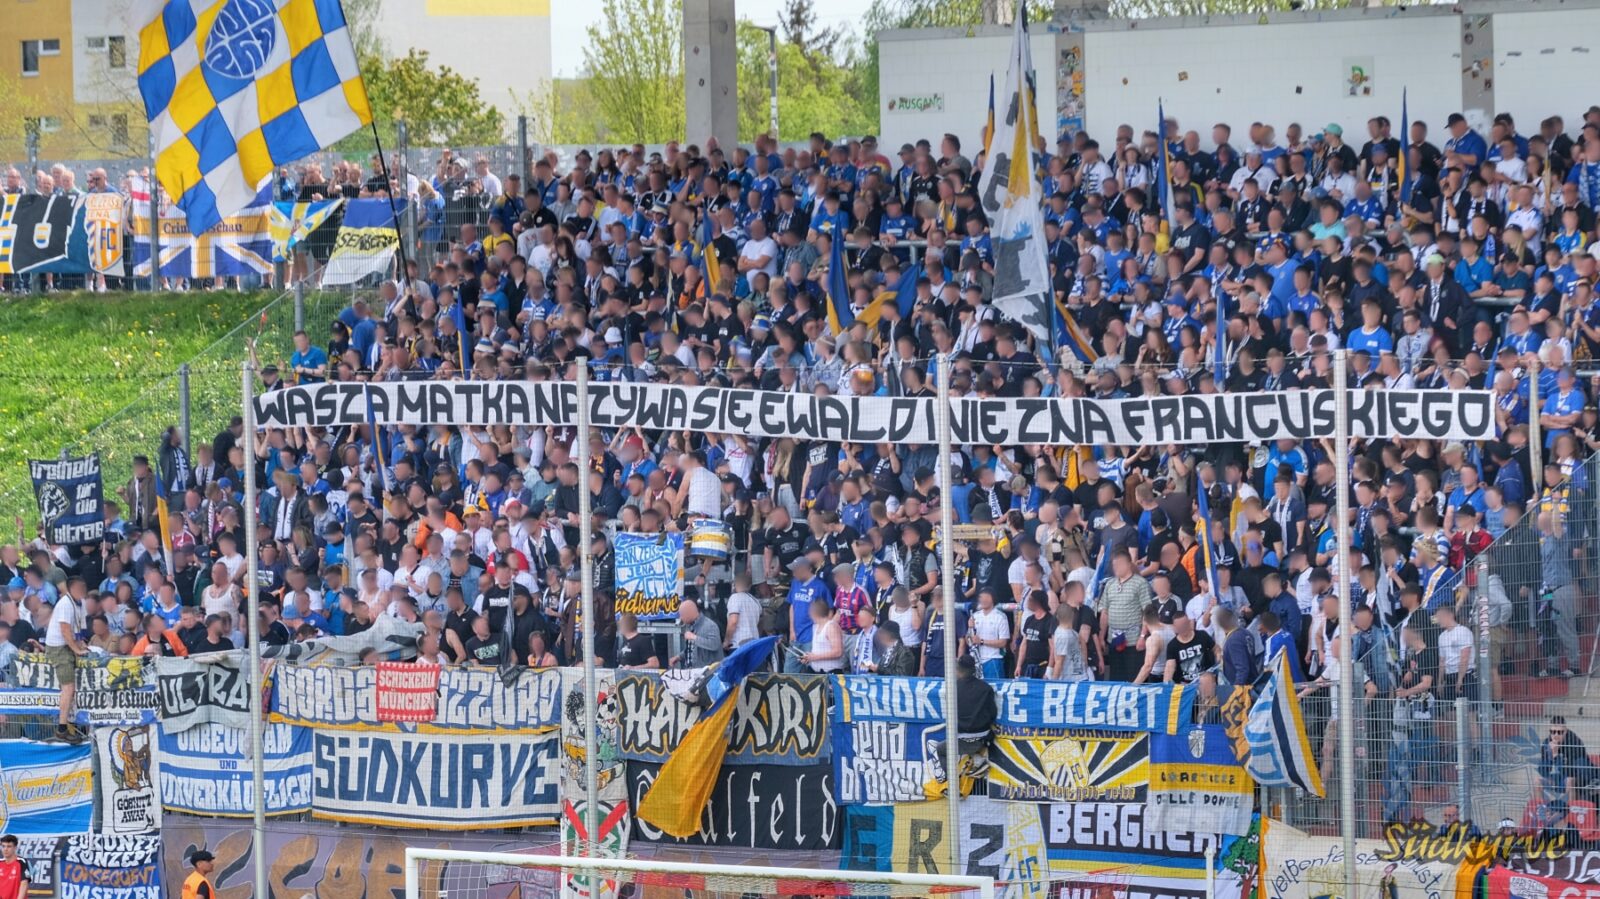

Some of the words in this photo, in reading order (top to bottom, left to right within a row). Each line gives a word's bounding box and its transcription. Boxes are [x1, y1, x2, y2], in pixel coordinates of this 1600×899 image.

[163, 221, 243, 234] Crimschau
[252, 383, 390, 426] WASZA
[397, 383, 530, 424] MATKA
[534, 383, 687, 428] NAZYWA
[691, 388, 754, 434] SIĘ
[759, 393, 918, 441] EWALD
[949, 398, 1009, 443] NIE
[1016, 399, 1116, 443] ZNA
[1120, 390, 1491, 443] FRANCUSKIEGO
[615, 589, 680, 615] üdkurve
[14, 660, 111, 692] WEIAR
[378, 688, 435, 711] MÜNCHEN
[849, 677, 1029, 724] SÜDKVE
[1043, 680, 1165, 729] BLEIBT
[621, 680, 822, 751] HAKIRI
[177, 724, 293, 755] UNBEUAM
[219, 760, 238, 770] UND
[314, 732, 560, 809] SÜDKURVE
[635, 768, 838, 849] Salfeld
[1156, 792, 1195, 805] DLLE
[66, 846, 157, 868] KONZEPT
[1271, 845, 1382, 899] eißenfeser
